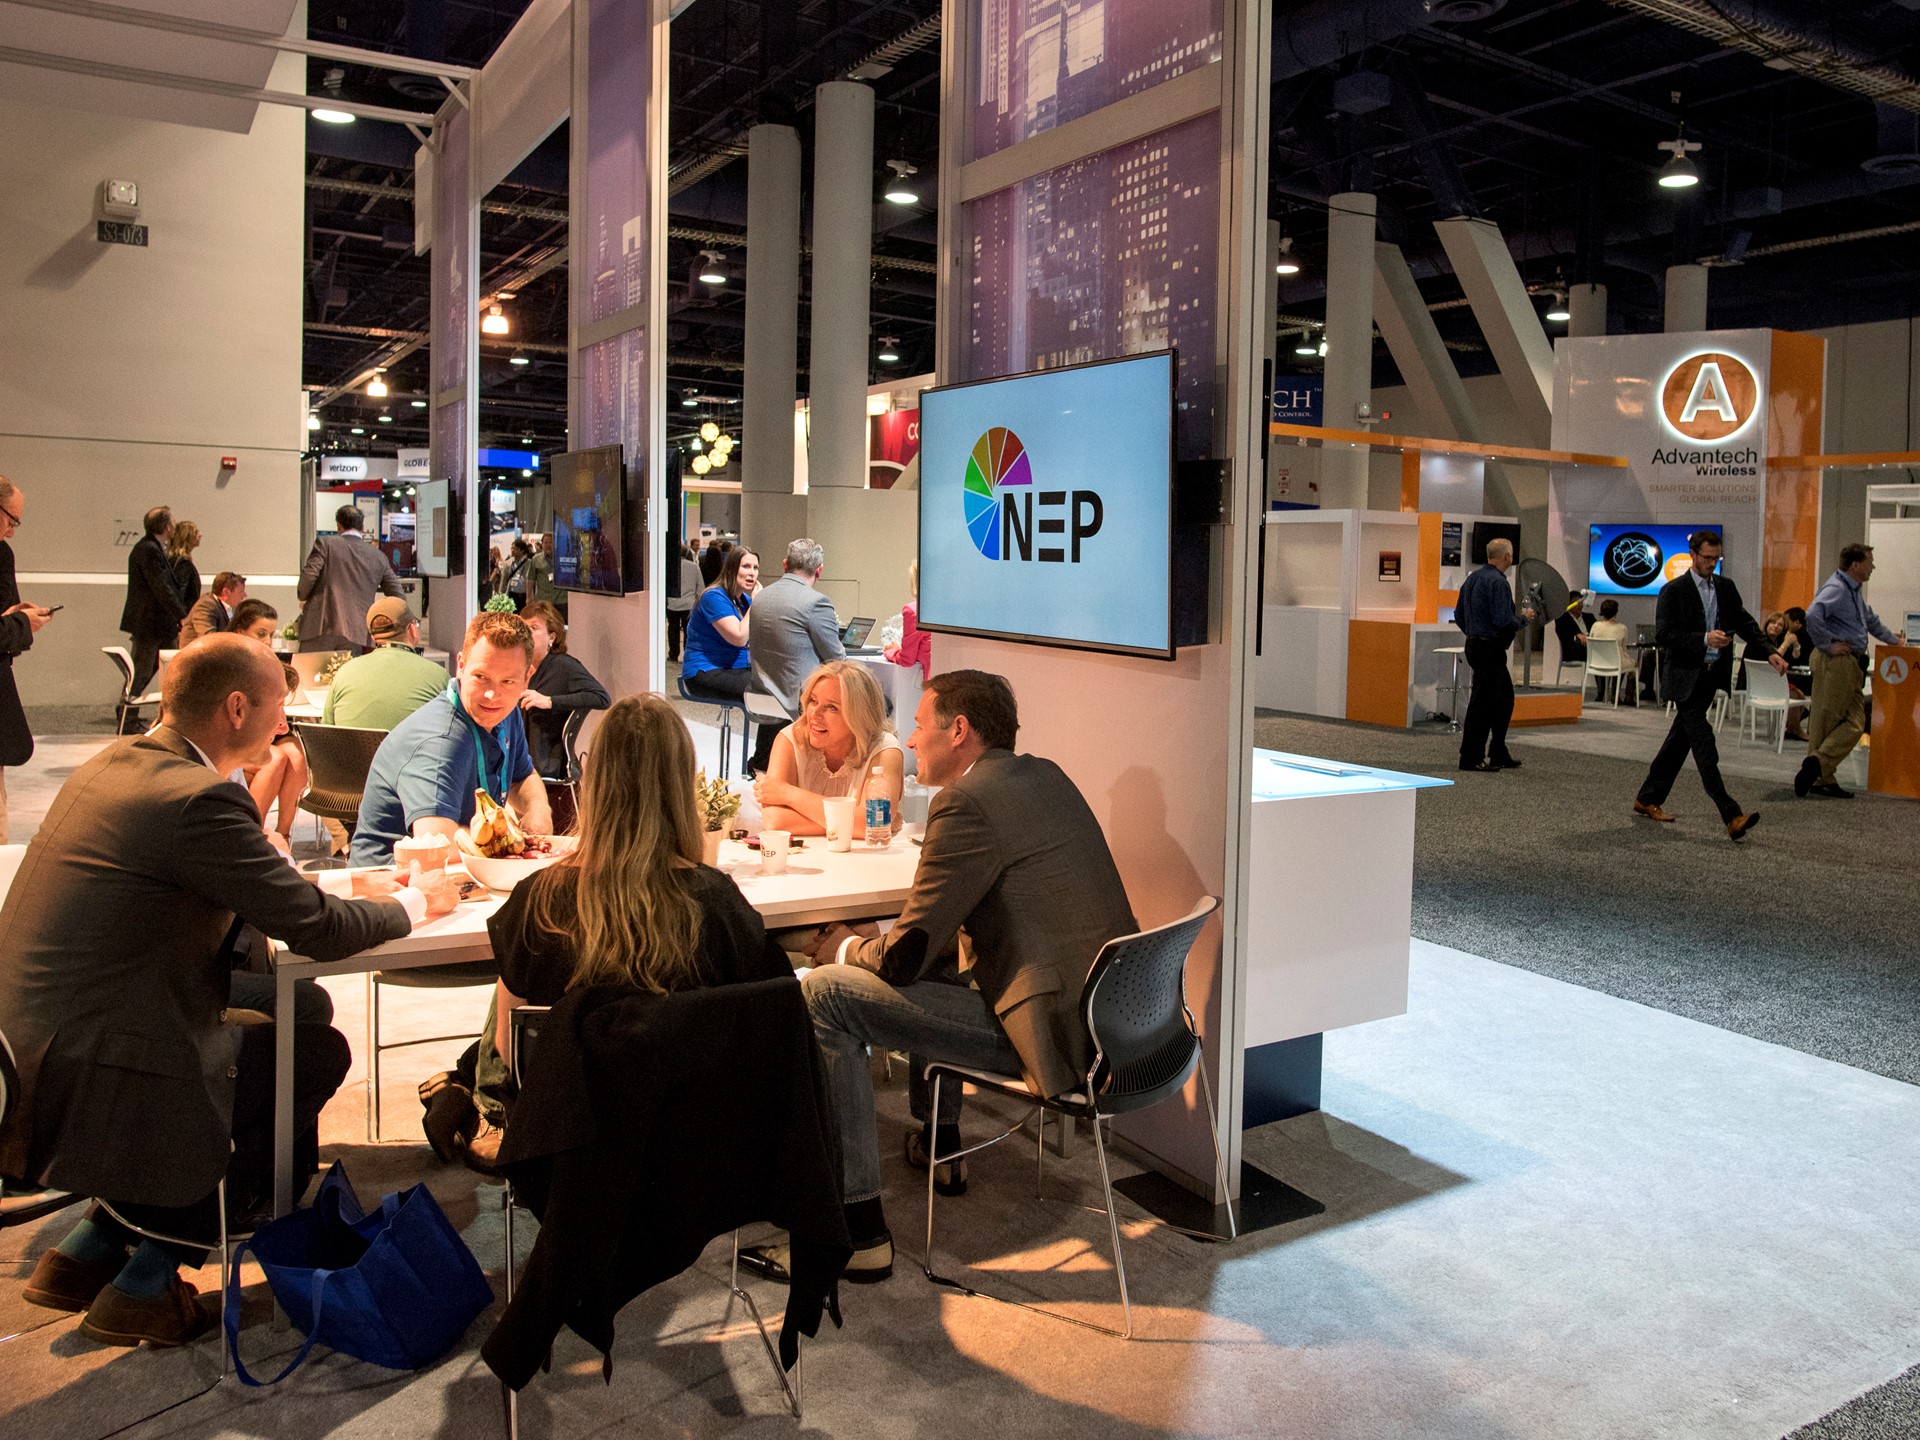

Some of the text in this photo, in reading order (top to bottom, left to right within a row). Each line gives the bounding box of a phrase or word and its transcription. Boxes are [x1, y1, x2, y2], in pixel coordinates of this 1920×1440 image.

[103, 222, 144, 245] S3-073
[1679, 362, 1738, 422] A
[1651, 448, 1758, 465] Advantech
[328, 463, 358, 473] verizon
[403, 458, 430, 467] GLOBE
[1696, 465, 1757, 476] Wireless
[1648, 484, 1756, 493] SMARTER SOLUTIONS
[1679, 495, 1756, 504] GLOBAL REACH
[1002, 490, 1104, 563] NEP
